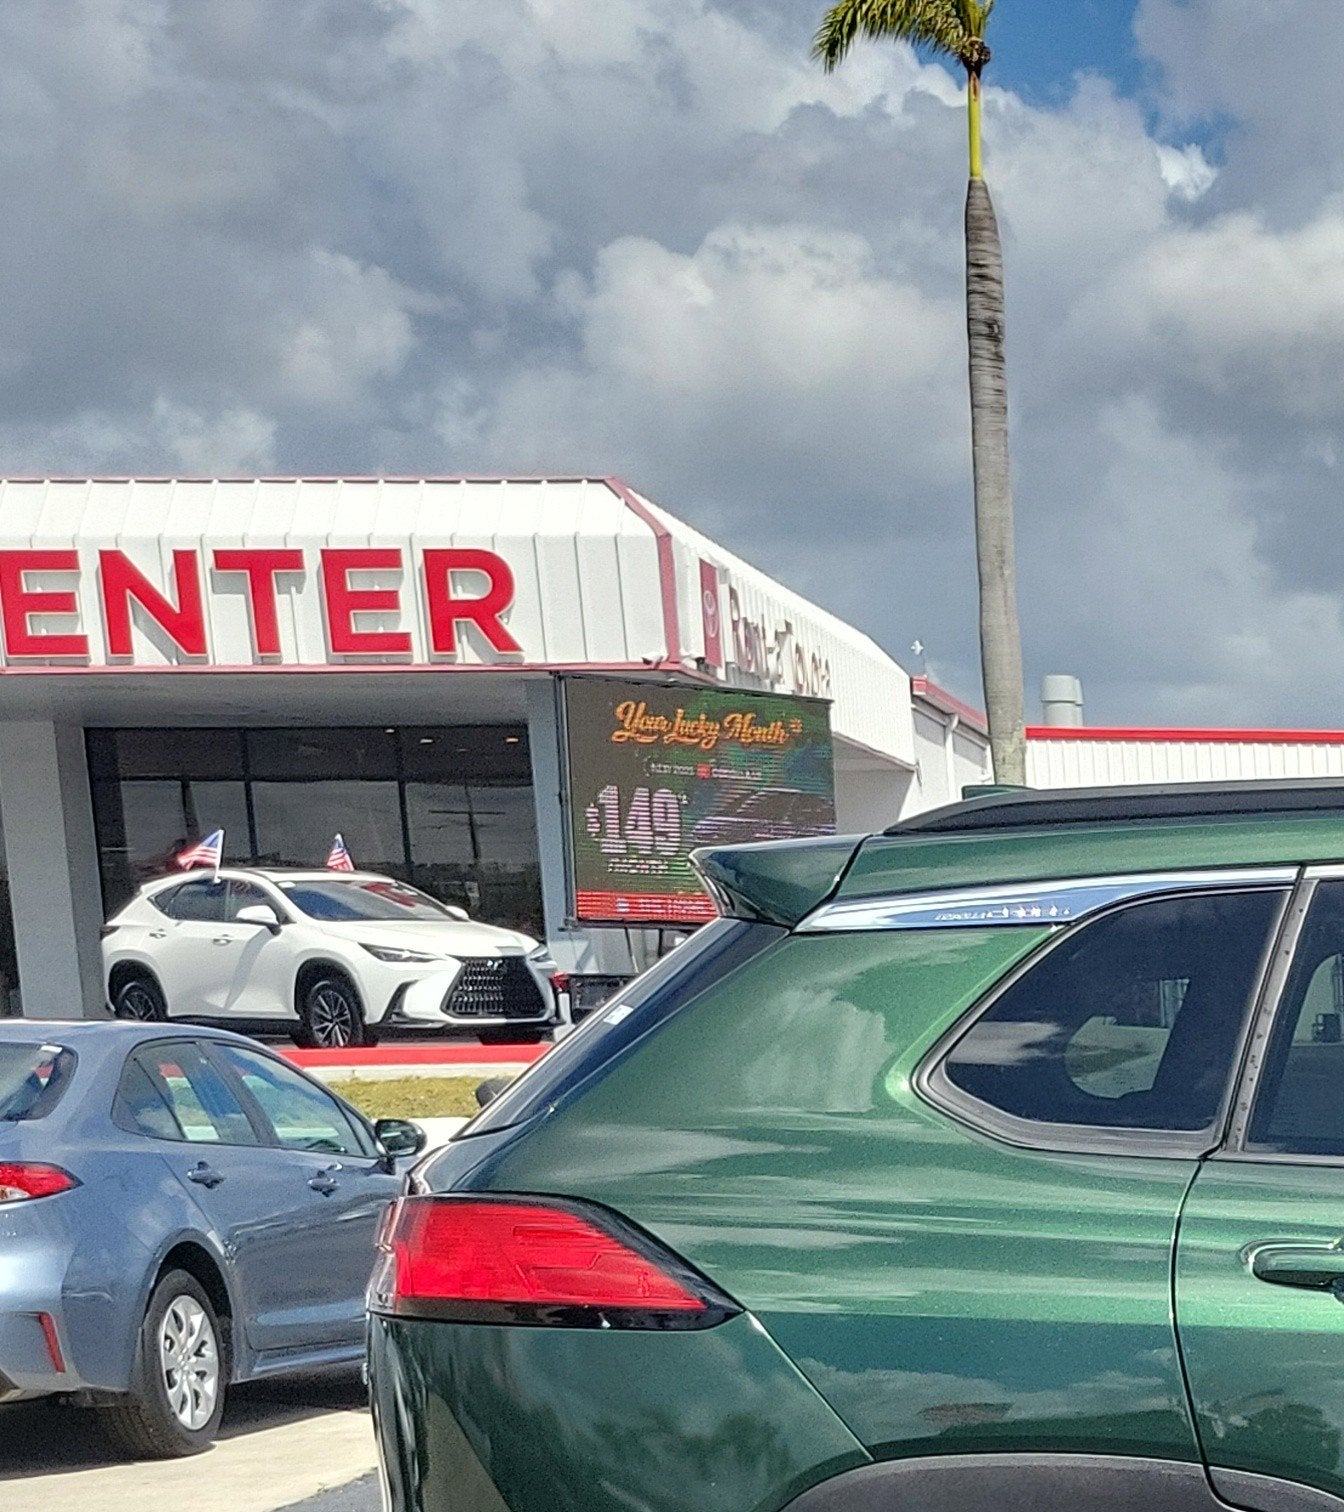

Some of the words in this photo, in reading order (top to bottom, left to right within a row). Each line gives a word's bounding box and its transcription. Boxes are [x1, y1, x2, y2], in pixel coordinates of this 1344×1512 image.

[0, 548, 525, 656] ENTER
[611, 701, 671, 744] Your
[663, 708, 720, 749] Lucky
[723, 713, 790, 745] Month
